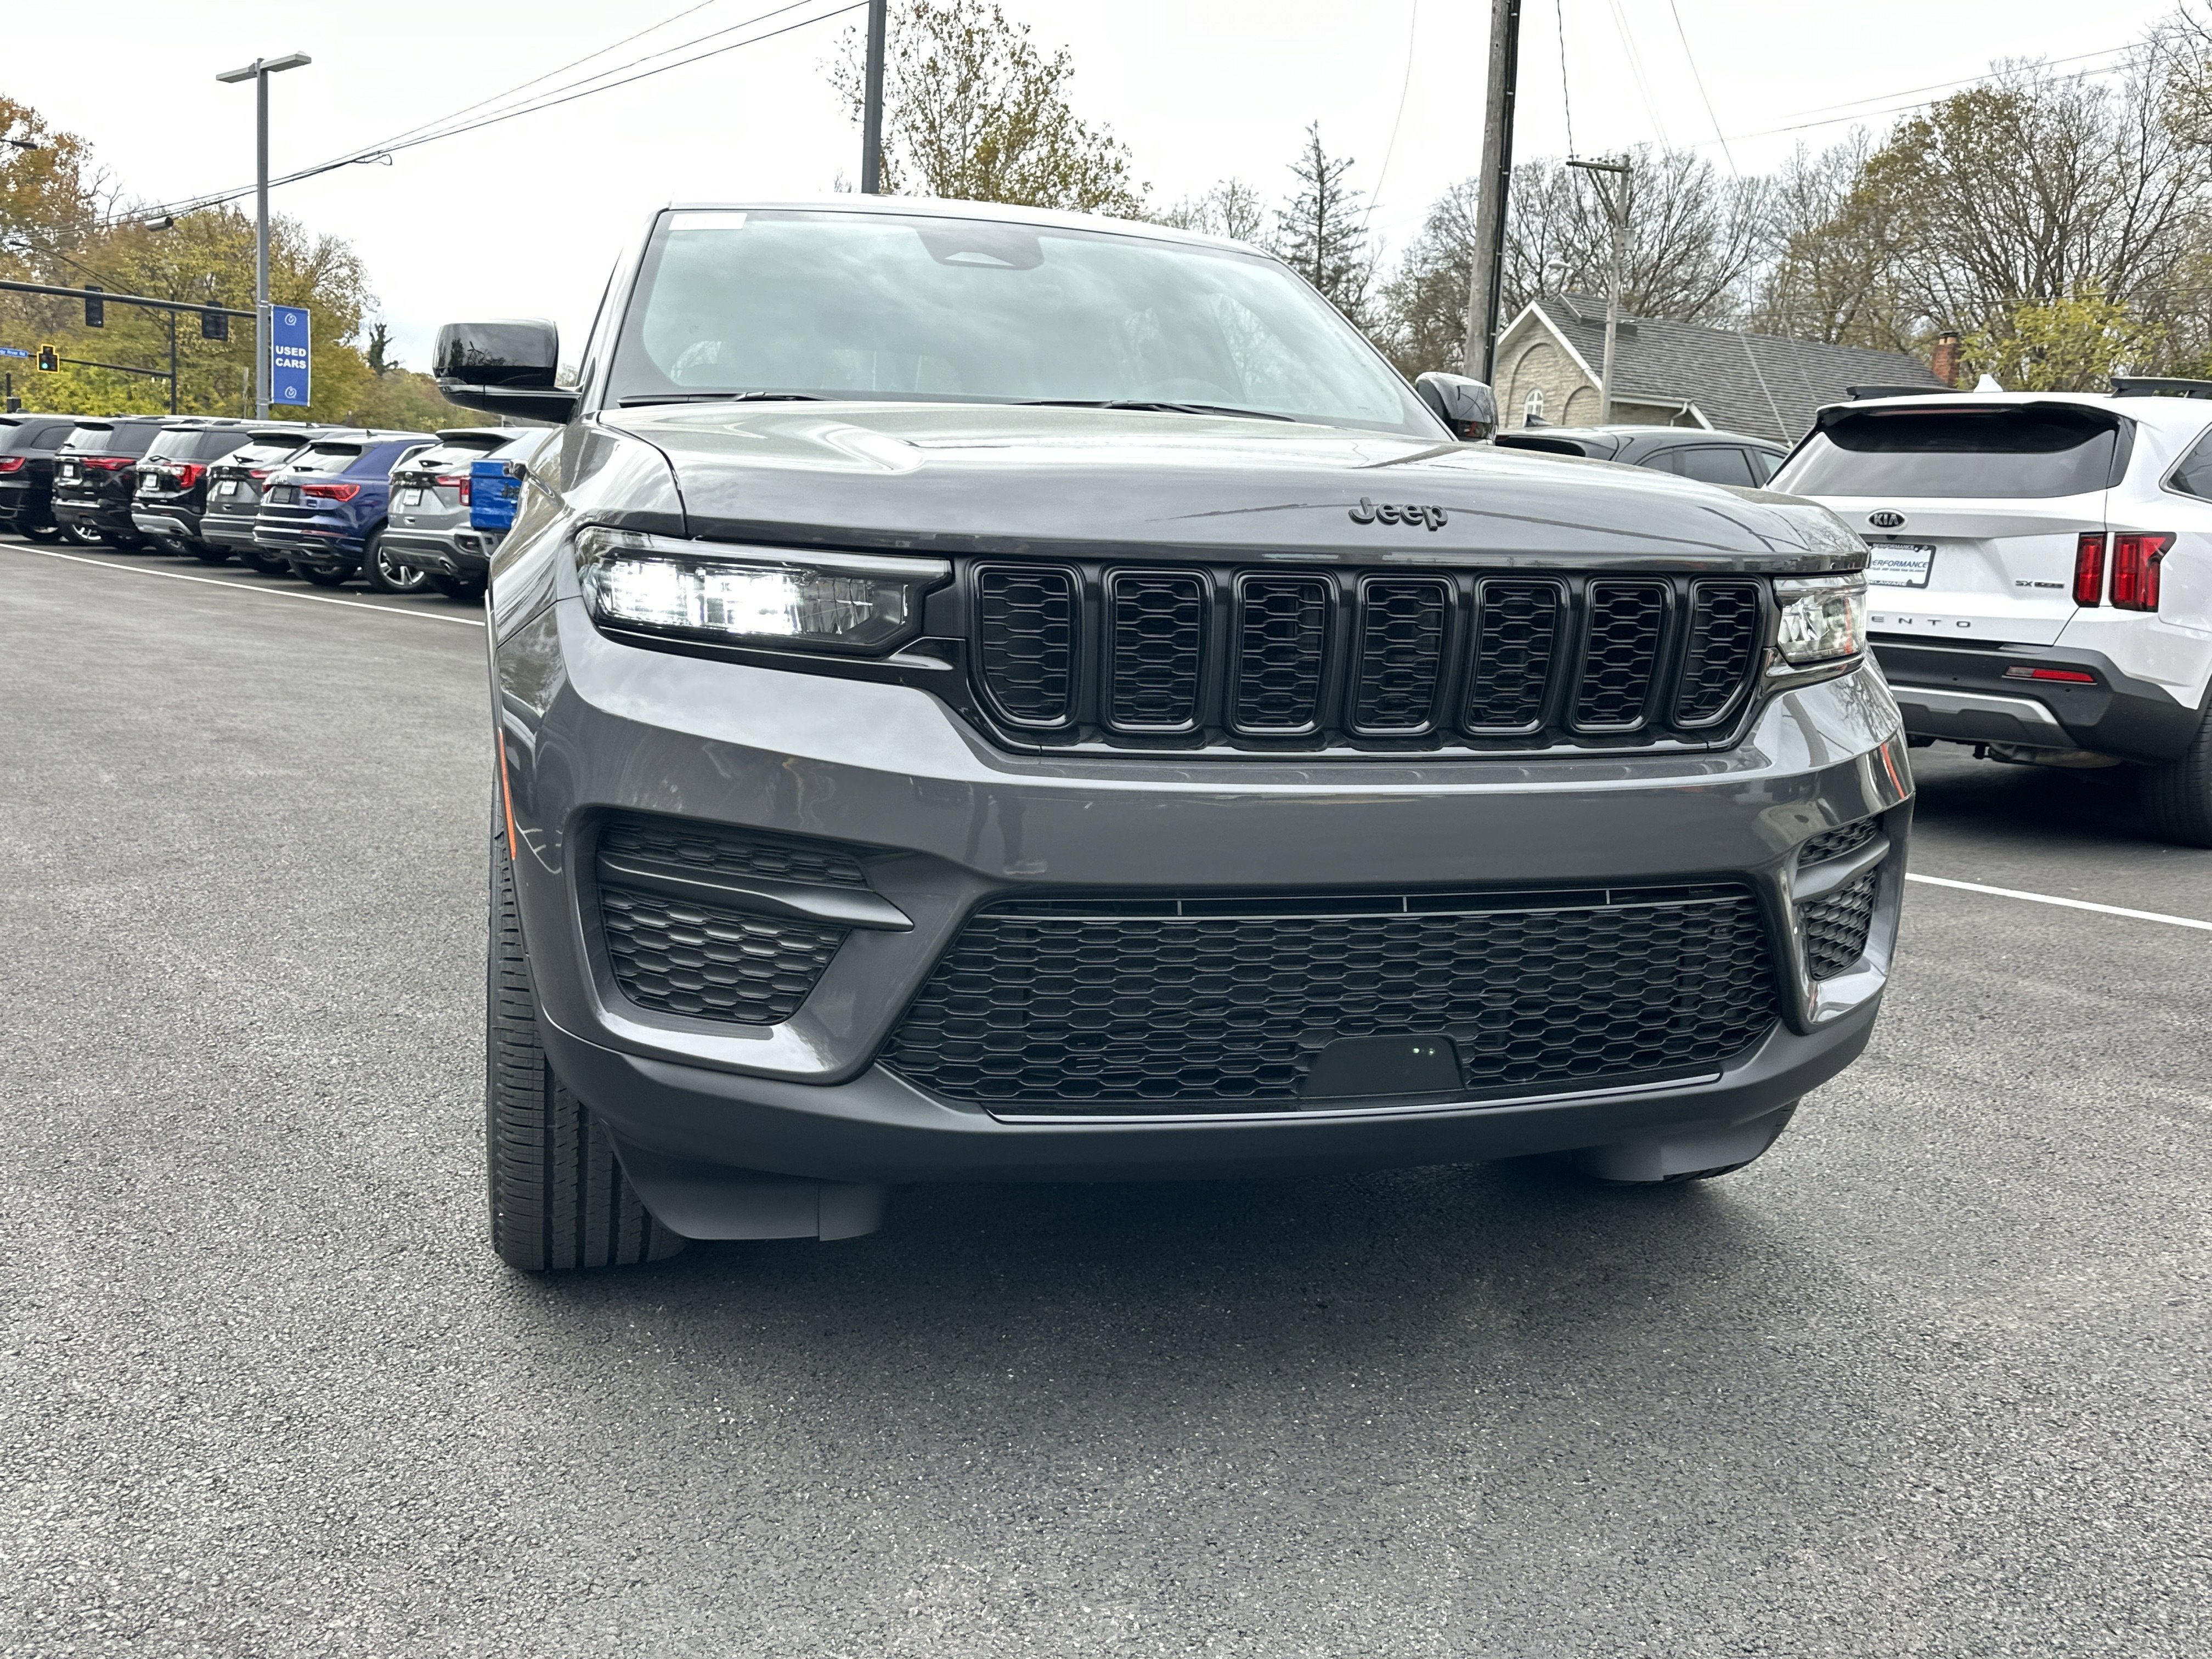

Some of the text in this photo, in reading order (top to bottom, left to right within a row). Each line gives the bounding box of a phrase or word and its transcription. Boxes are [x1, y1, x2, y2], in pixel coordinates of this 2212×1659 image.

[275, 345, 307, 357] USED
[275, 358, 307, 369] CARS
[1348, 496, 1448, 532] Jeep
[1874, 514, 1899, 525] KIA
[1872, 560, 1929, 568] ERFORMANCE
[1871, 616, 1971, 628] ENTO
